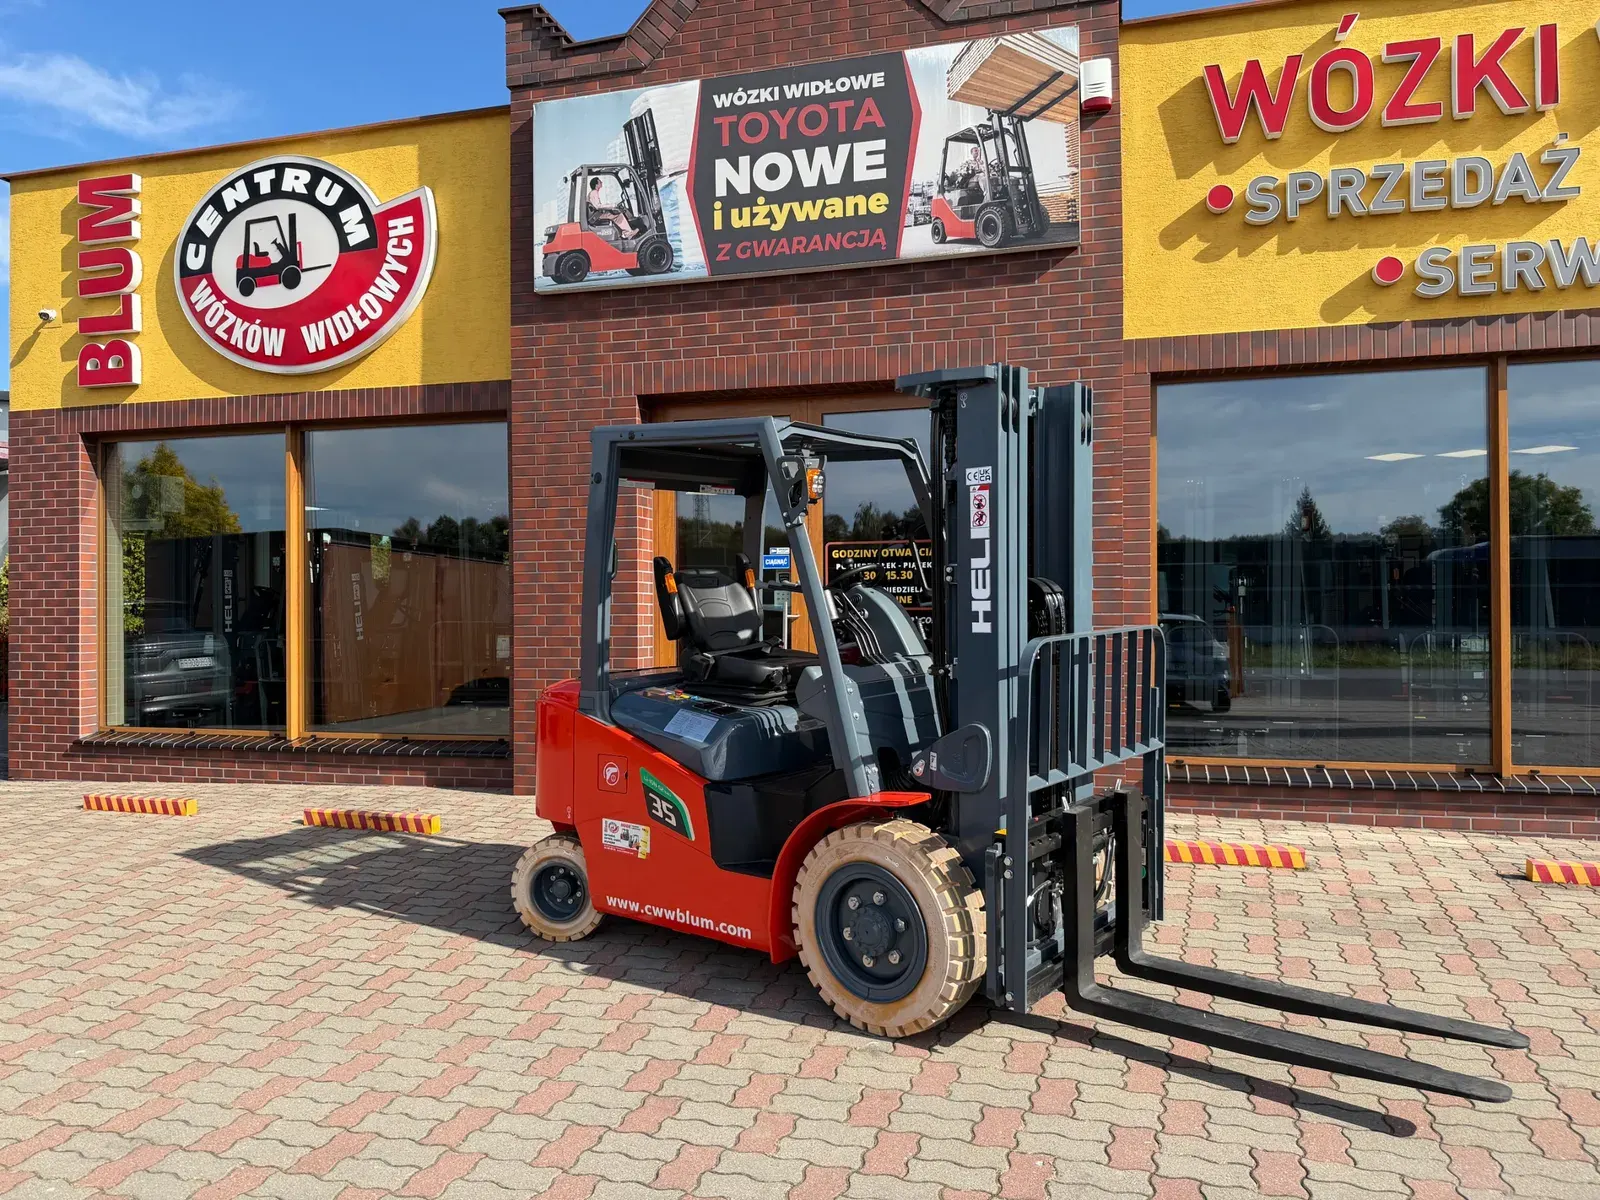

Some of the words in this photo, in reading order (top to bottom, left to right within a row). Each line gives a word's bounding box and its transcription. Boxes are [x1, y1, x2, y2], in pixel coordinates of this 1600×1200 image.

[713, 87, 780, 108] WÓZKI
[783, 72, 885, 99] WIDŁOWE
[1203, 12, 1560, 144] WÓZKI
[713, 97, 886, 147] TOYOTA
[715, 139, 887, 197] NOWE
[1244, 132, 1582, 226] SPRZEDAŻ
[186, 167, 371, 271] CENTRUM
[713, 201, 723, 231] i
[730, 192, 890, 232] używane
[715, 243, 732, 261] Z
[736, 228, 887, 259] GWARANCJĄ
[1413, 236, 1600, 299] SERW
[78, 173, 142, 389] BLUM
[190, 278, 286, 358] WÓZKÓW
[300, 215, 415, 354] WIDŁOWYCH
[831, 549, 878, 558] GODZINY
[881, 548, 932, 557] OTWACI
[885, 570, 913, 580] 15.30
[903, 561, 933, 571] PIĄEK
[970, 527, 992, 633] HELI
[648, 792, 677, 827] 35
[605, 895, 752, 940] www.cwwblum.com
